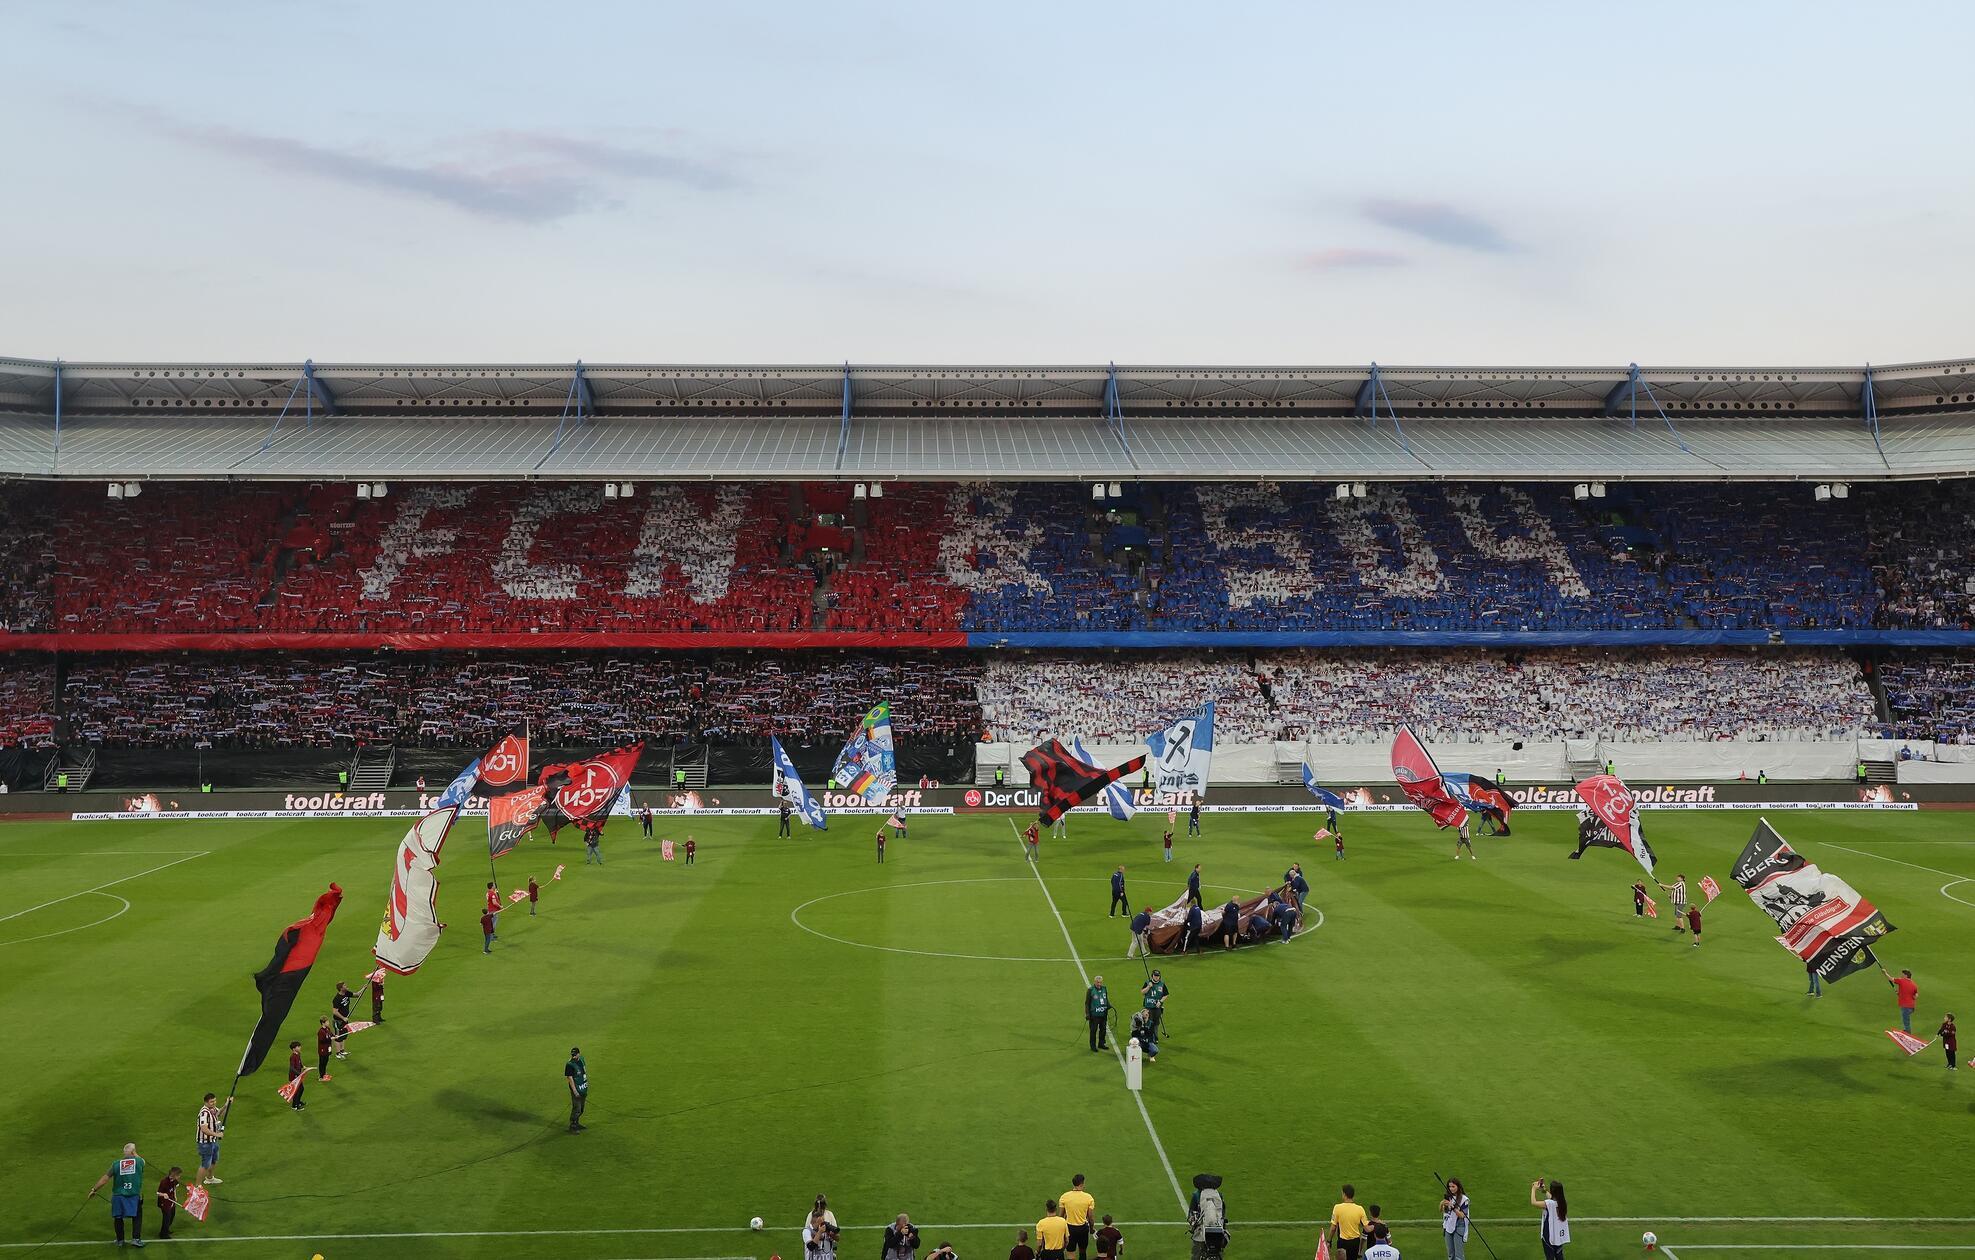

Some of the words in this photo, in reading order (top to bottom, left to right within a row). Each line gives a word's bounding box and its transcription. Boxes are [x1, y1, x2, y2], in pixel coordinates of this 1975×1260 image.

[285, 792, 386, 810] toolcraft
[823, 790, 922, 807] toolraft
[984, 790, 1012, 806] Der
[1630, 785, 1716, 803] oolcraft
[123, 1182, 133, 1190] 23
[1372, 1250, 1391, 1258] HRS
